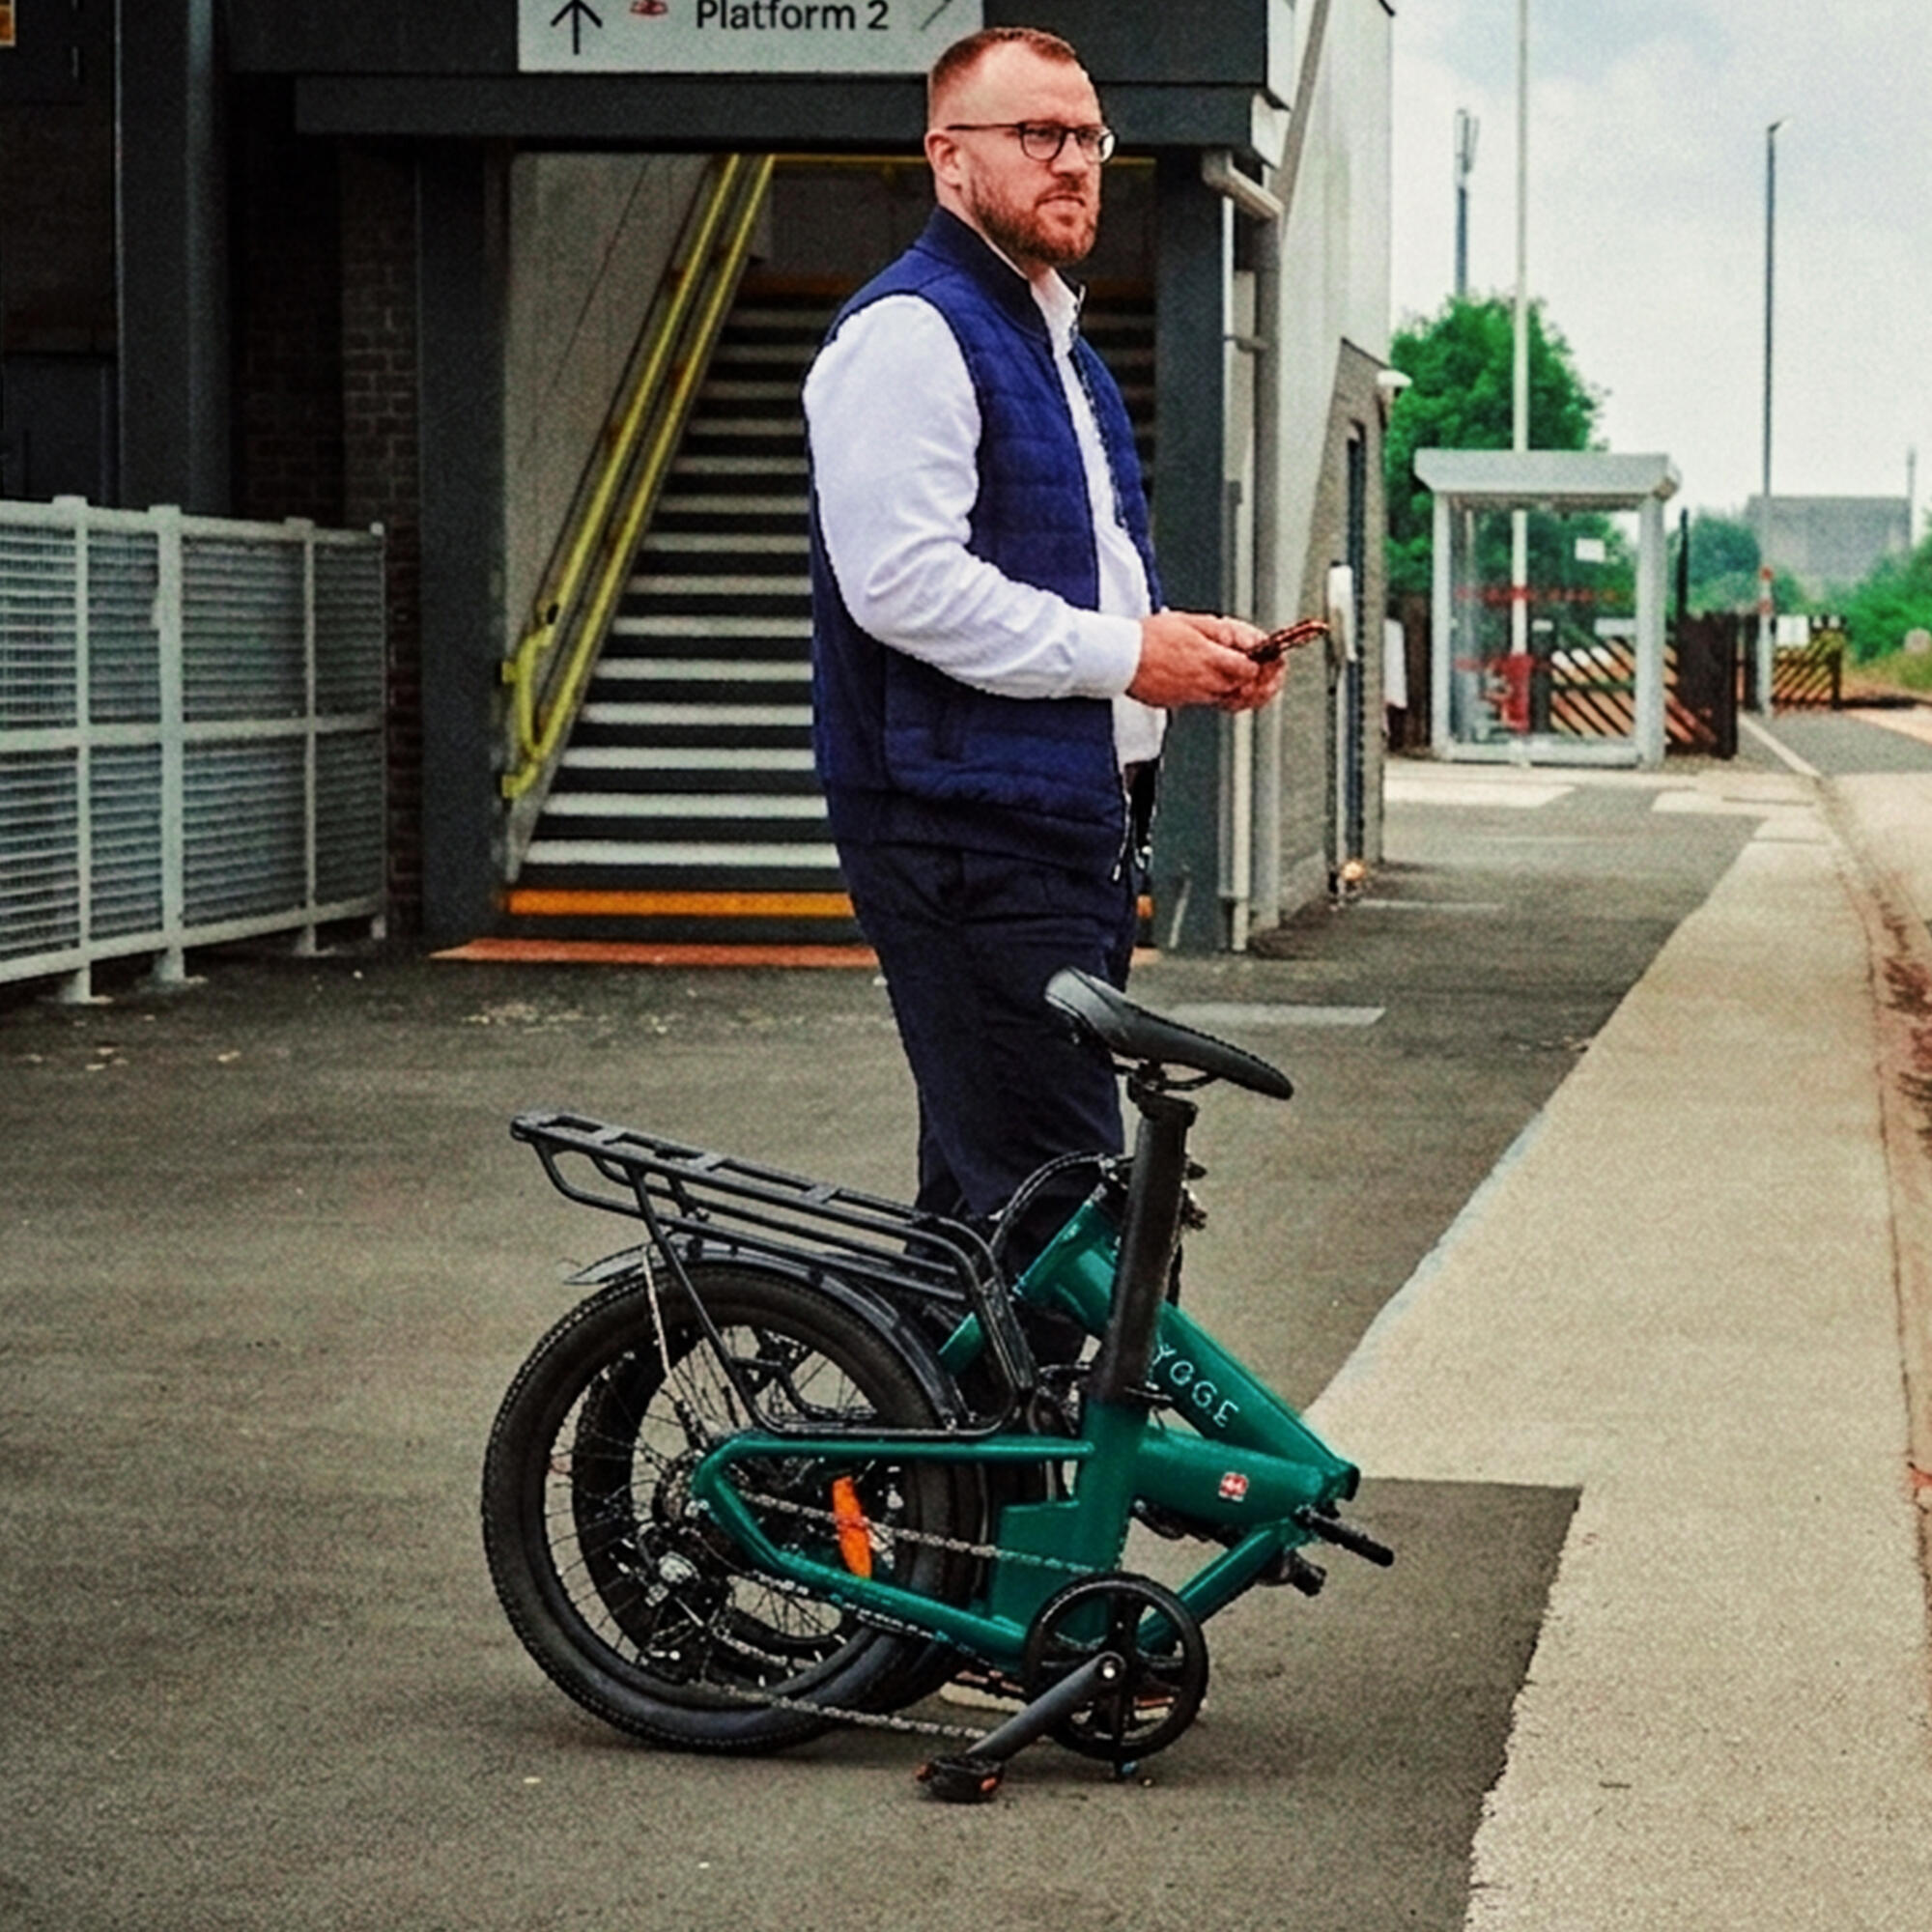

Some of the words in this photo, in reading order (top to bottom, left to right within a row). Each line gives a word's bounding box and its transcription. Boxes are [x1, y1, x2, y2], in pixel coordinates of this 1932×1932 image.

[696, 0, 856, 30] Platform
[867, 0, 890, 30] 2
[1152, 1343, 1239, 1428] YGGE
